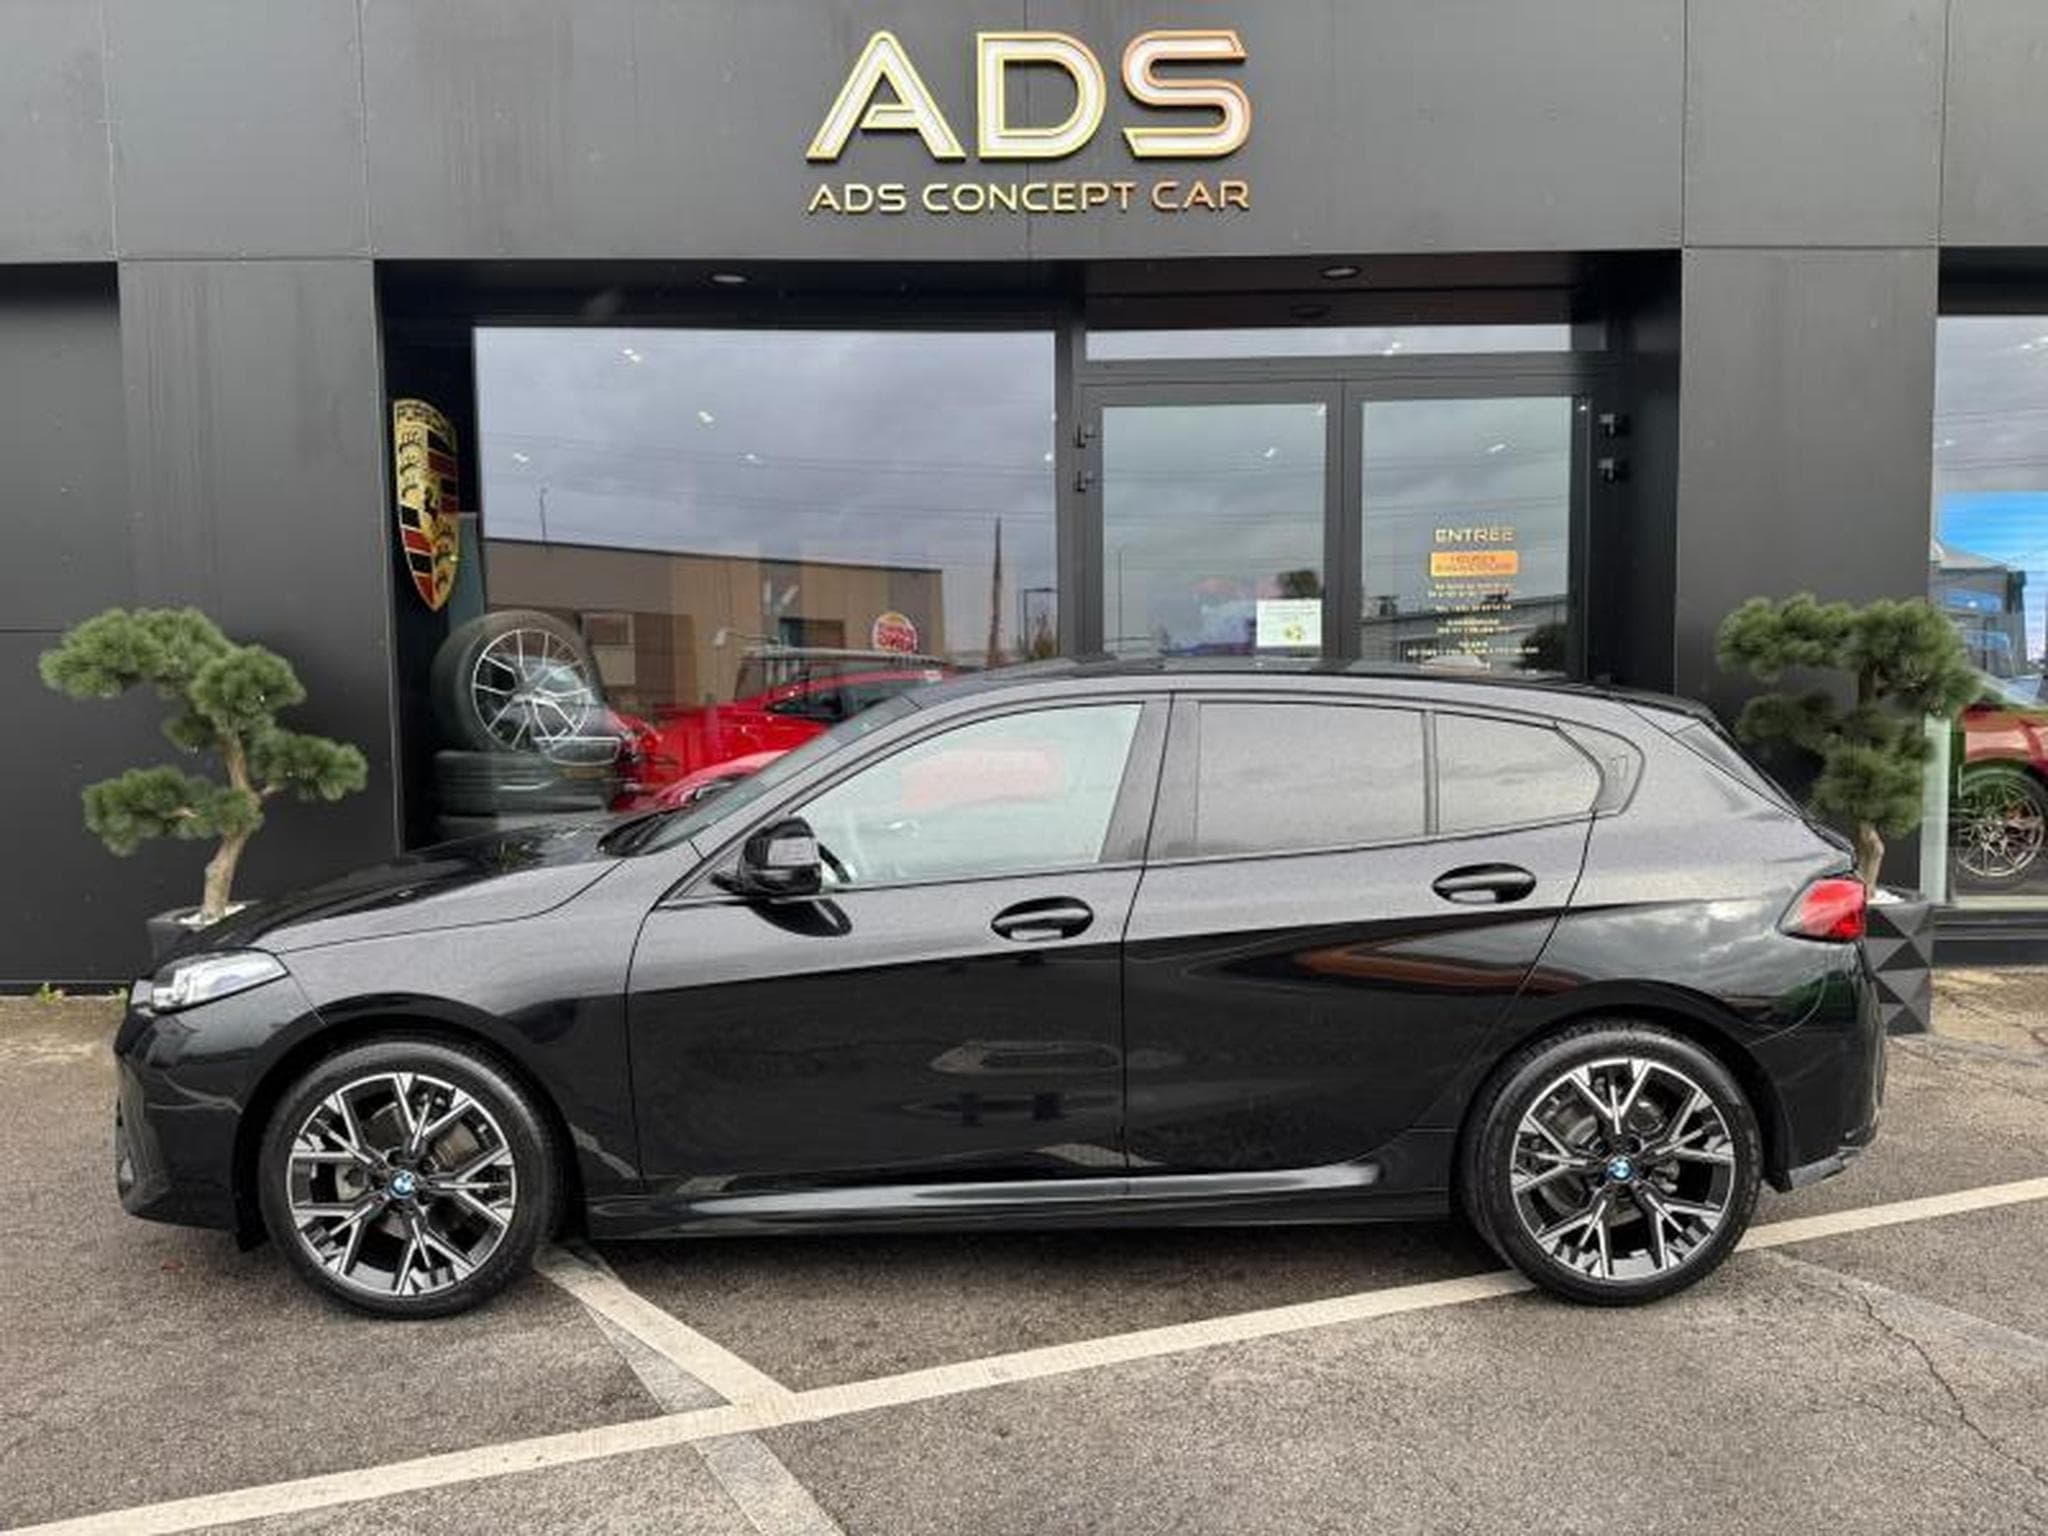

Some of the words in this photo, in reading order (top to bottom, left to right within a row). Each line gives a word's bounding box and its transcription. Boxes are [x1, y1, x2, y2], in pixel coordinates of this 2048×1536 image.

[806, 30, 1252, 161] ADS
[808, 184, 907, 213] ADS
[922, 182, 1137, 213] CONCEPT
[1151, 180, 1250, 209] CAR
